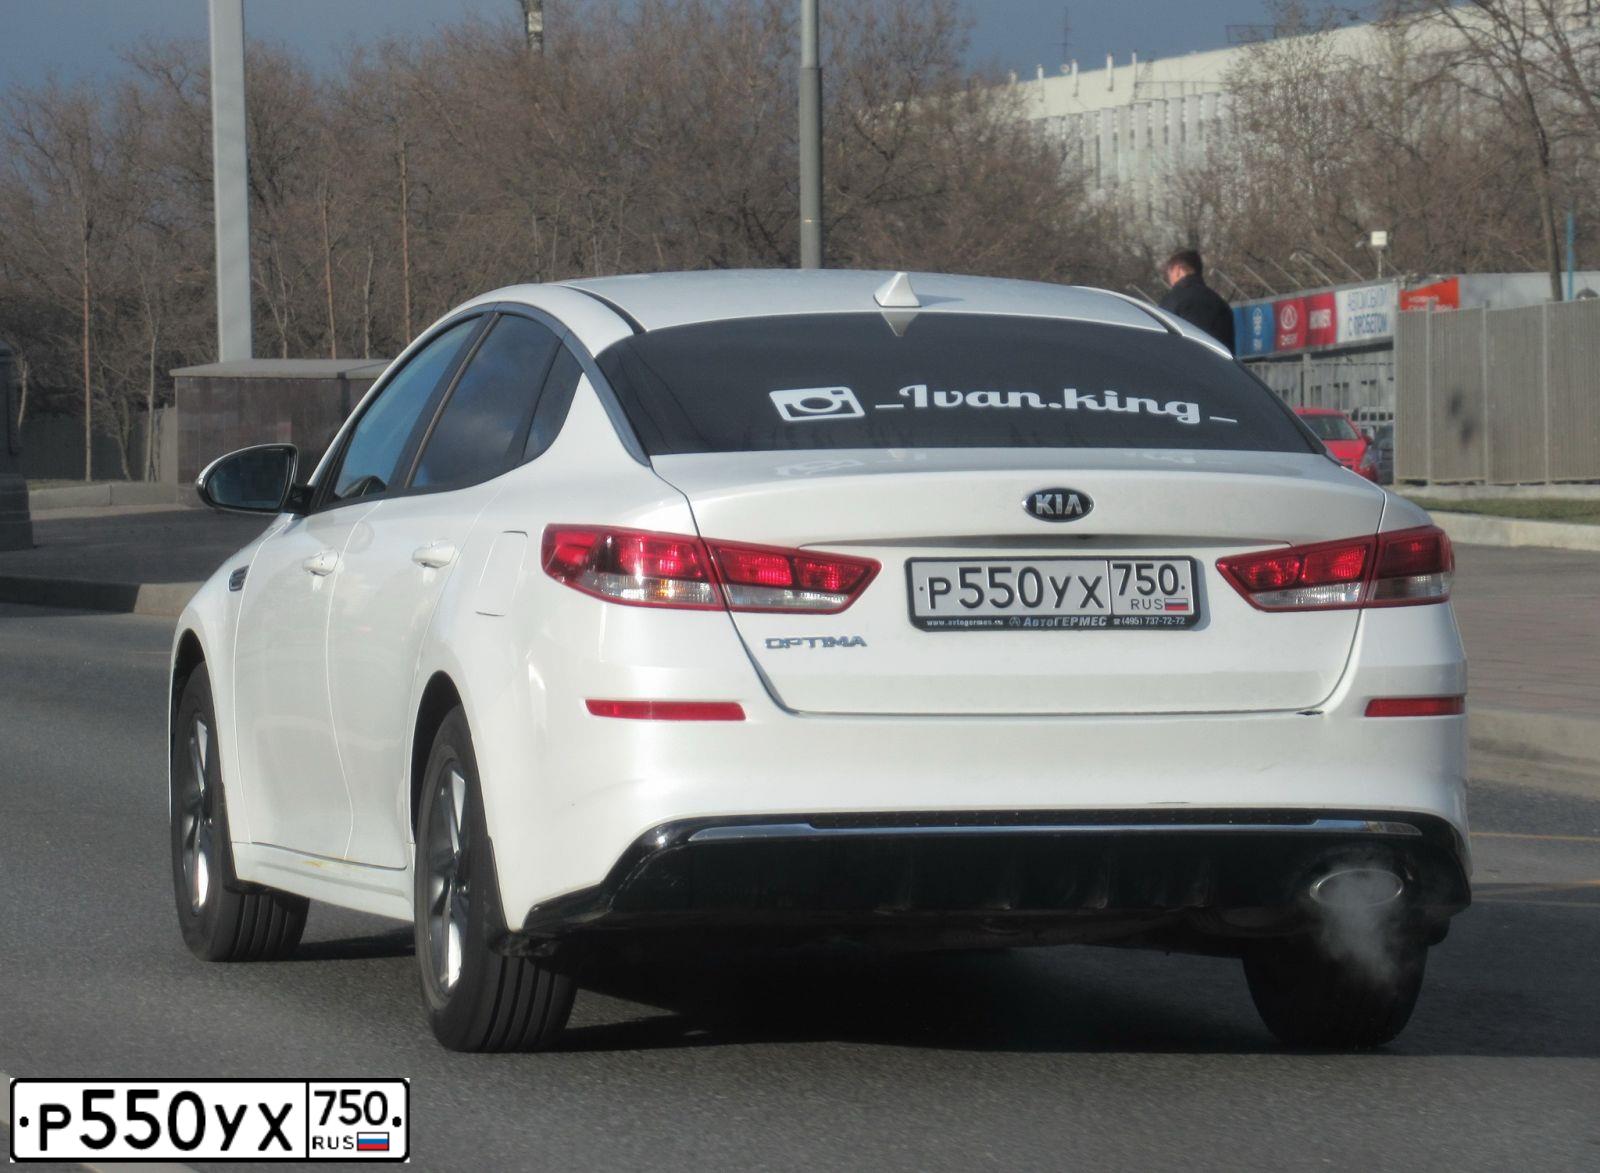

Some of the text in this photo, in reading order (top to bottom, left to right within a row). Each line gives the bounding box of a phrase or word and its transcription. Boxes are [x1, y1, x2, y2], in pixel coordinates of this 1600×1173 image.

[1035, 493, 1083, 513] KIA
[1112, 563, 1179, 596] 750
[1131, 598, 1163, 611] RUS
[1023, 616, 1107, 628] АвтоГЕРМЕС
[1122, 616, 1142, 625] (495)
[1145, 616, 1185, 625] 737-72-72
[765, 635, 868, 649] OPTIMA
